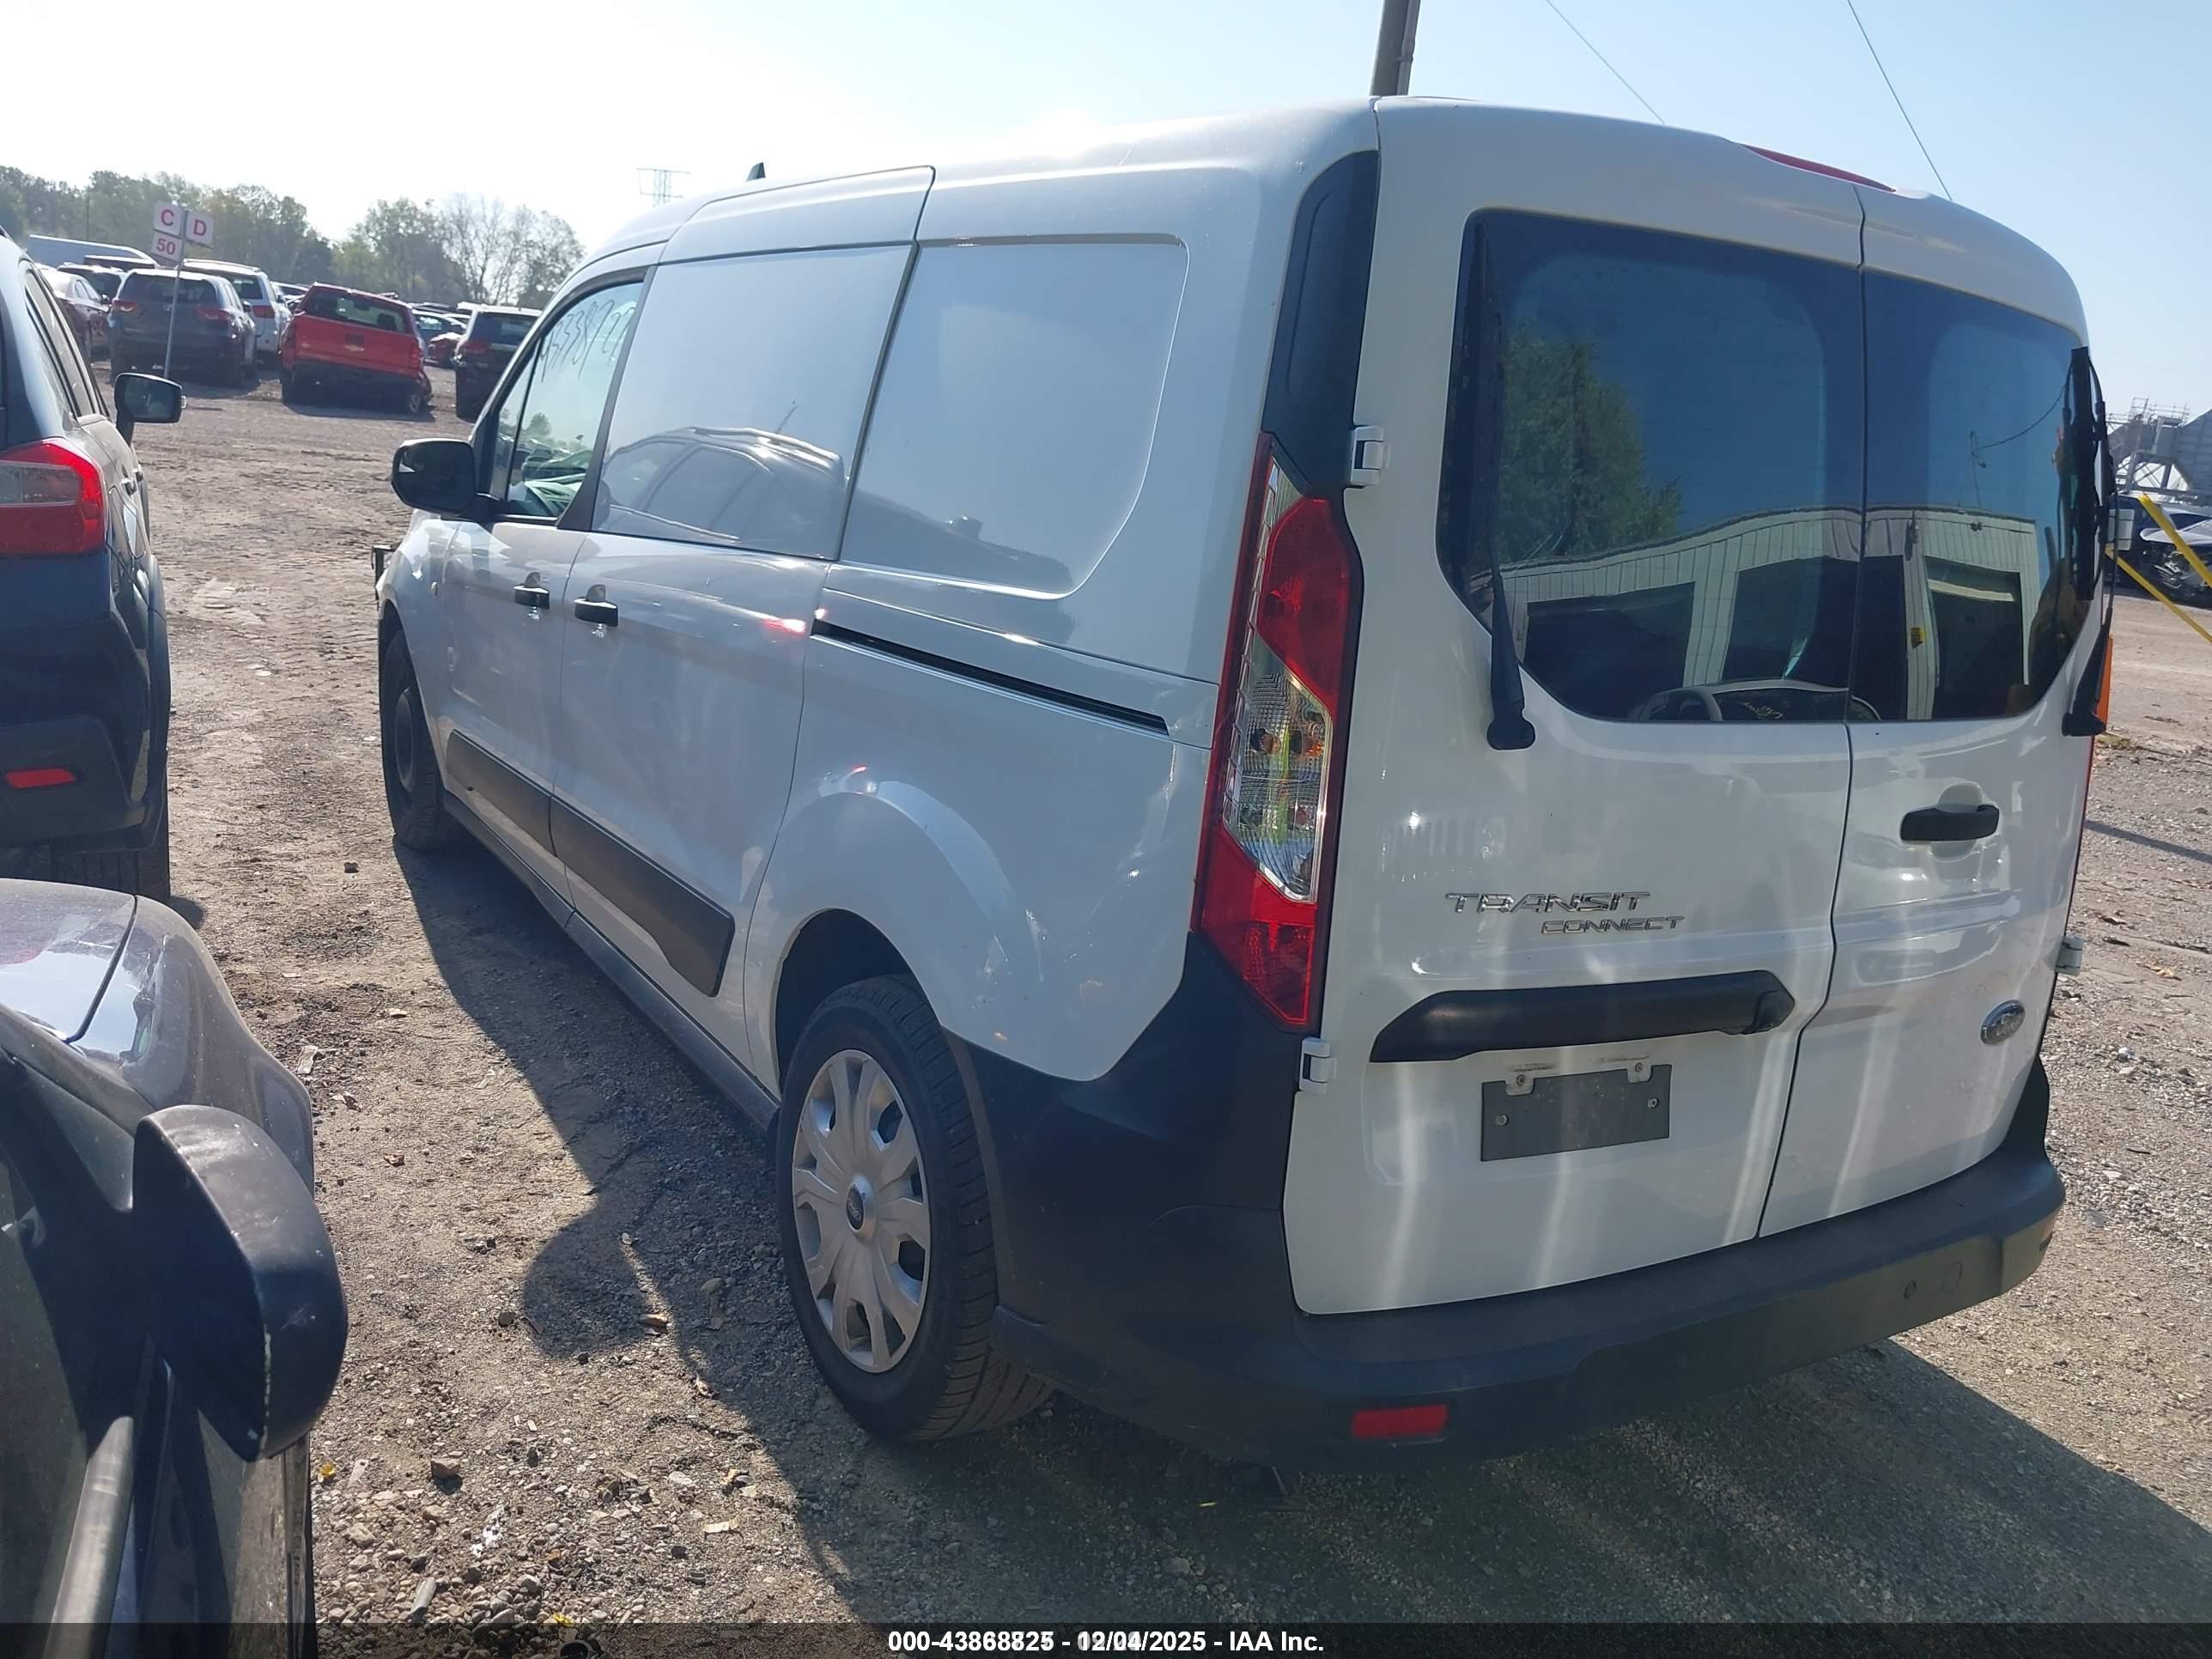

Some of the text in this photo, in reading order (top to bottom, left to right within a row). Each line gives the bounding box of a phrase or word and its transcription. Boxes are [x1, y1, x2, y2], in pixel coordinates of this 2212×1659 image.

[161, 209, 174, 226] C
[193, 218, 207, 236] D
[156, 238, 176, 255] 50
[1445, 891, 1651, 914] TRANSIT
[1540, 915, 1685, 935] CONNECT
